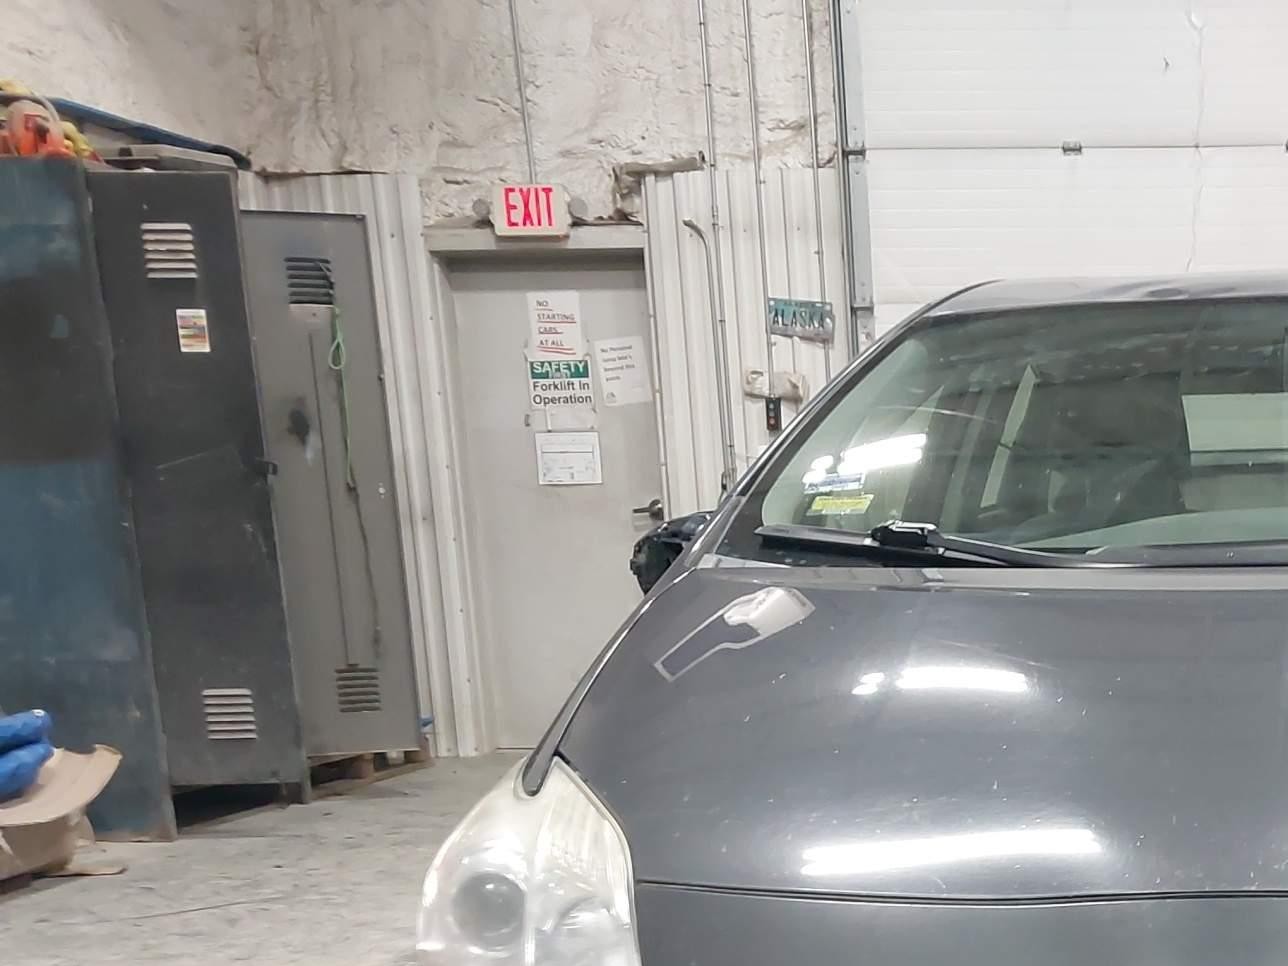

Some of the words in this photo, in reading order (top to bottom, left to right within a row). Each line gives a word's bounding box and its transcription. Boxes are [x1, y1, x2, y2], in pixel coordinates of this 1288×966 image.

[504, 187, 553, 227] EXIT
[535, 299, 549, 307] NO
[536, 312, 576, 320] STARTING
[772, 307, 825, 330] ALASKA
[532, 361, 585, 373] SAFETY
[532, 380, 575, 391] Forklift
[578, 379, 590, 391] In
[532, 393, 592, 407] Operation
